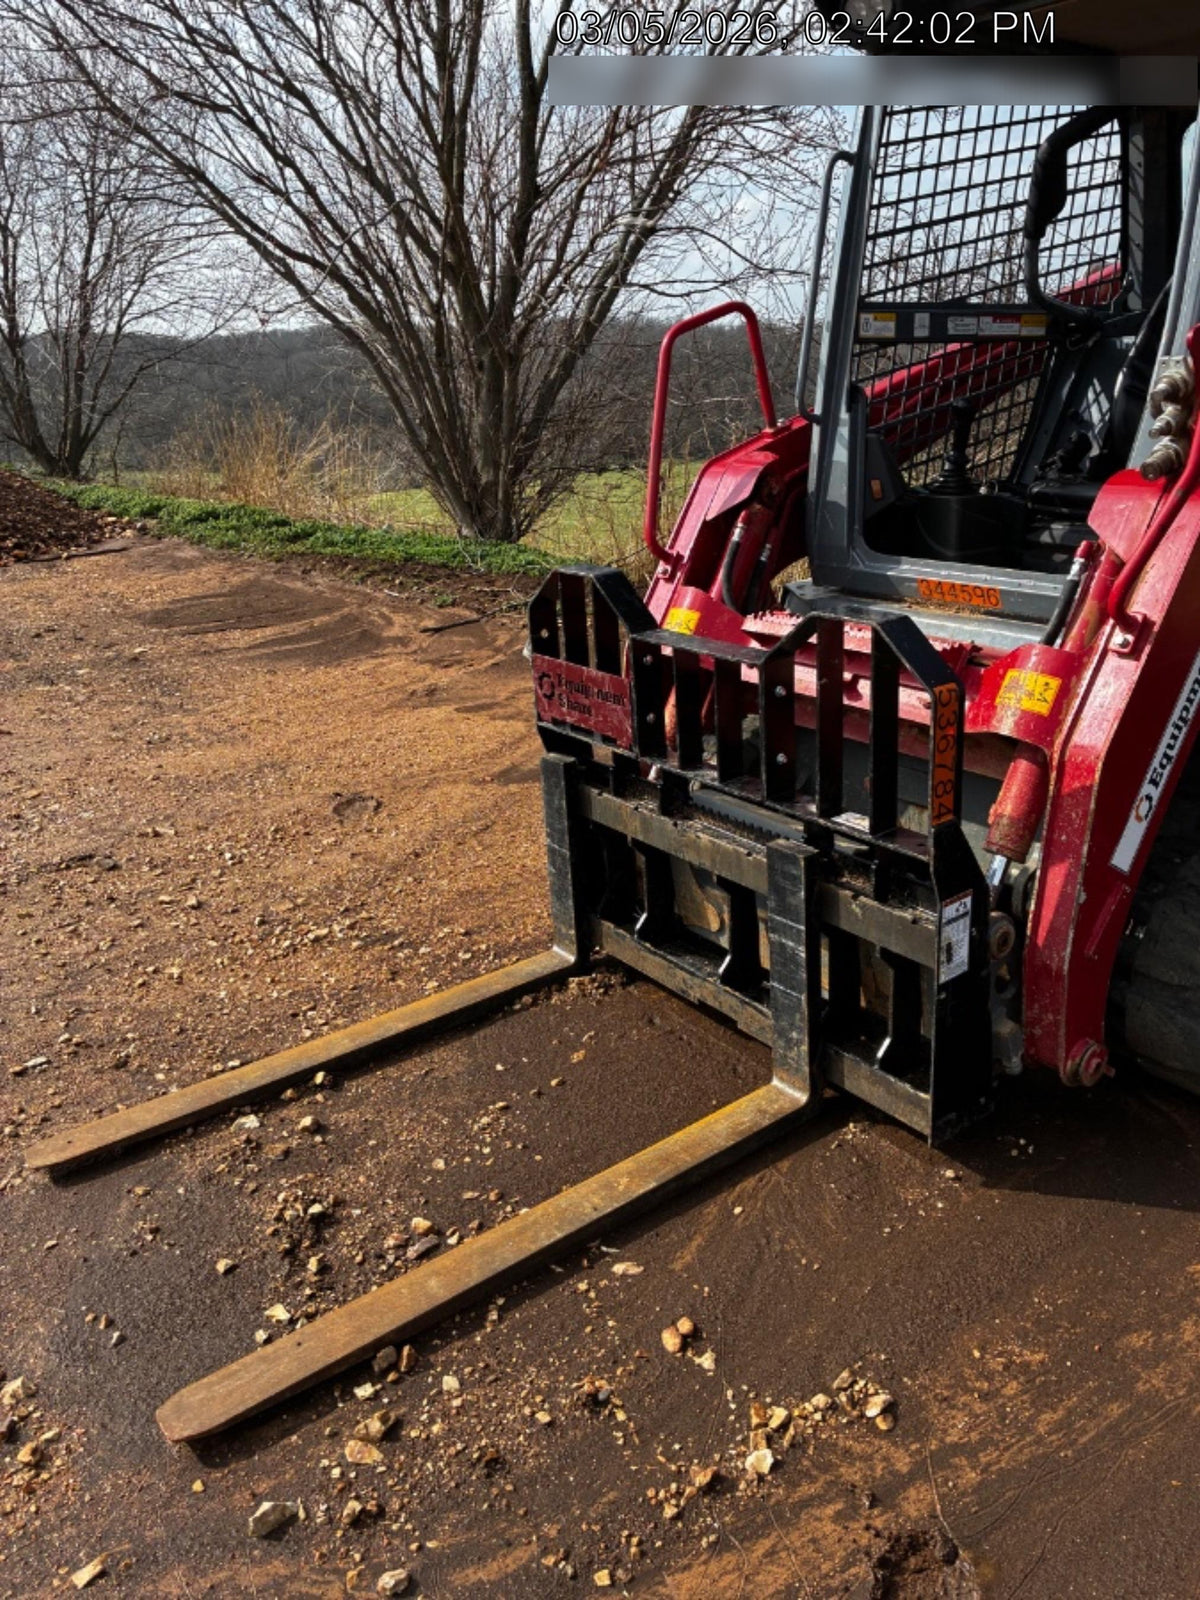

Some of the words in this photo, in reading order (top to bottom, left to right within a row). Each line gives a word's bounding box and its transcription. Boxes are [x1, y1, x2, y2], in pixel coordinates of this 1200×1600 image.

[919, 578, 1000, 608] 344596
[932, 688, 957, 819] 536784
[1148, 666, 1200, 790] Equipm
